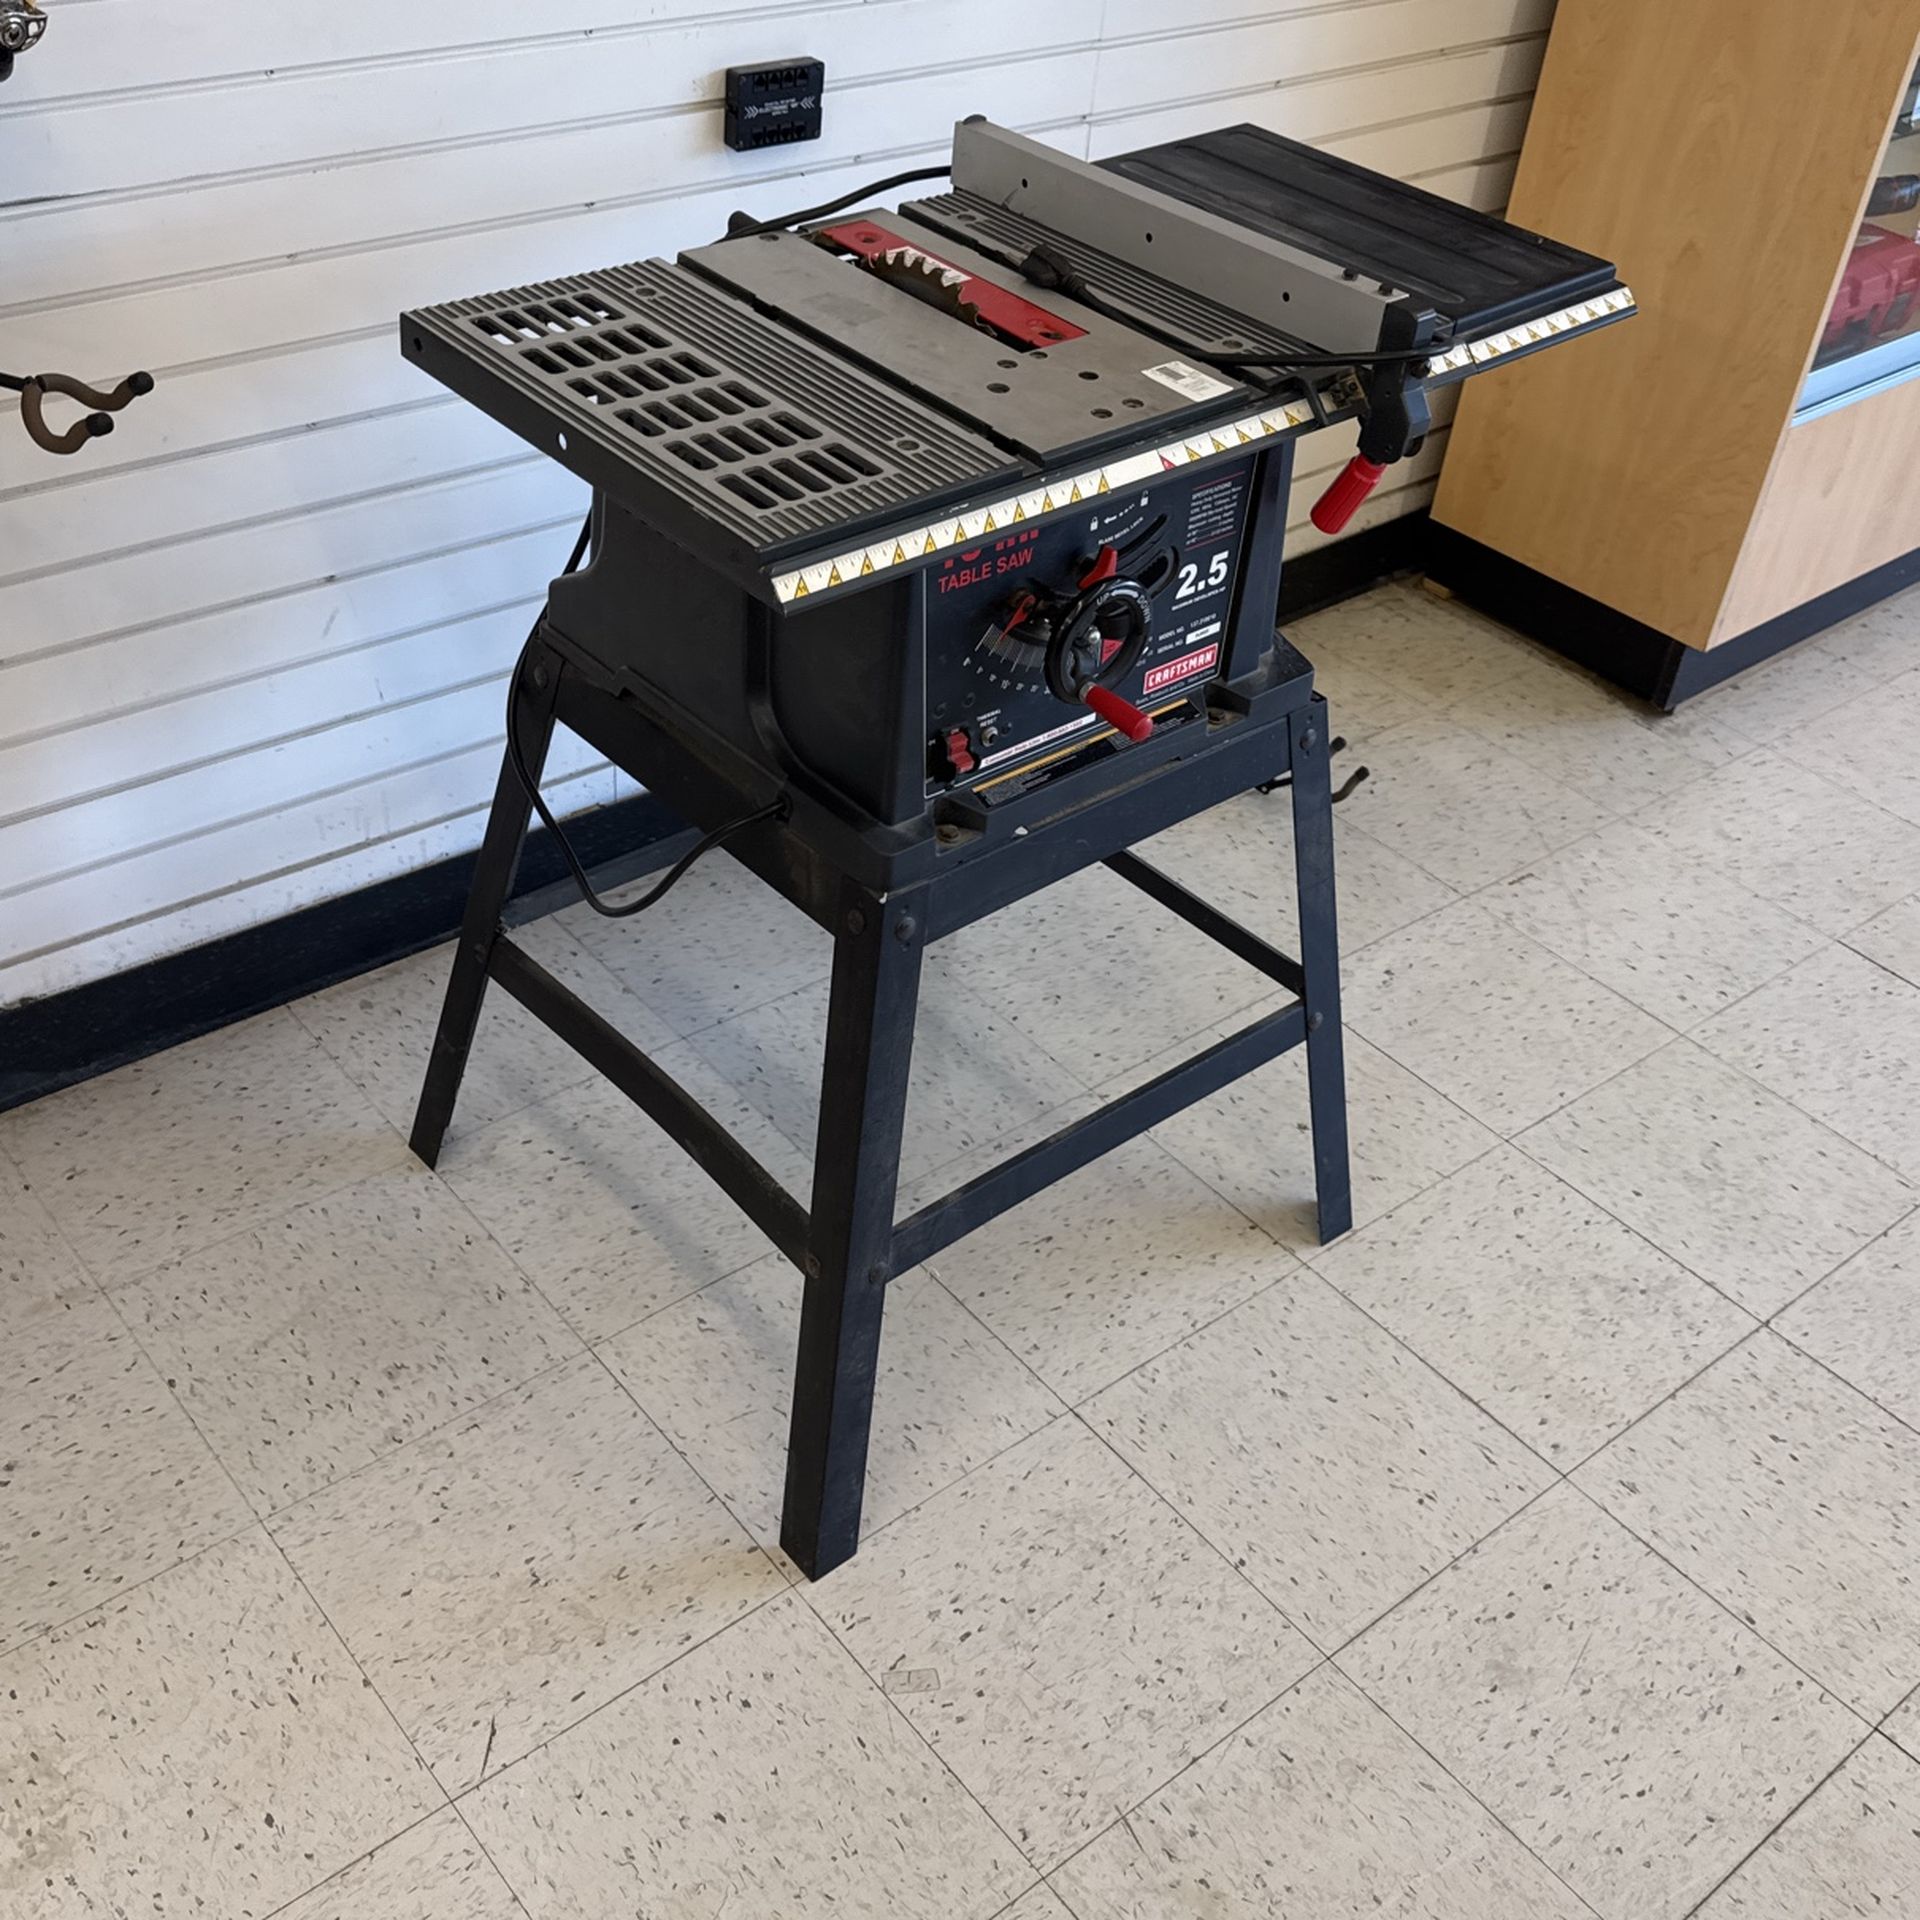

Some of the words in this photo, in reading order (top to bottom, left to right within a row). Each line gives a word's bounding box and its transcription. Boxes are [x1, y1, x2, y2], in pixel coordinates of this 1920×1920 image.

[938, 560, 992, 594] TABLE
[996, 546, 1034, 574] SAW
[1174, 549, 1230, 601] 2.5
[1096, 591, 1110, 606] UP
[1136, 594, 1152, 624] DOWN
[1158, 631, 1175, 641] MODEL
[1147, 648, 1214, 688] CRAFTSMAN
[980, 716, 998, 728] RESET
